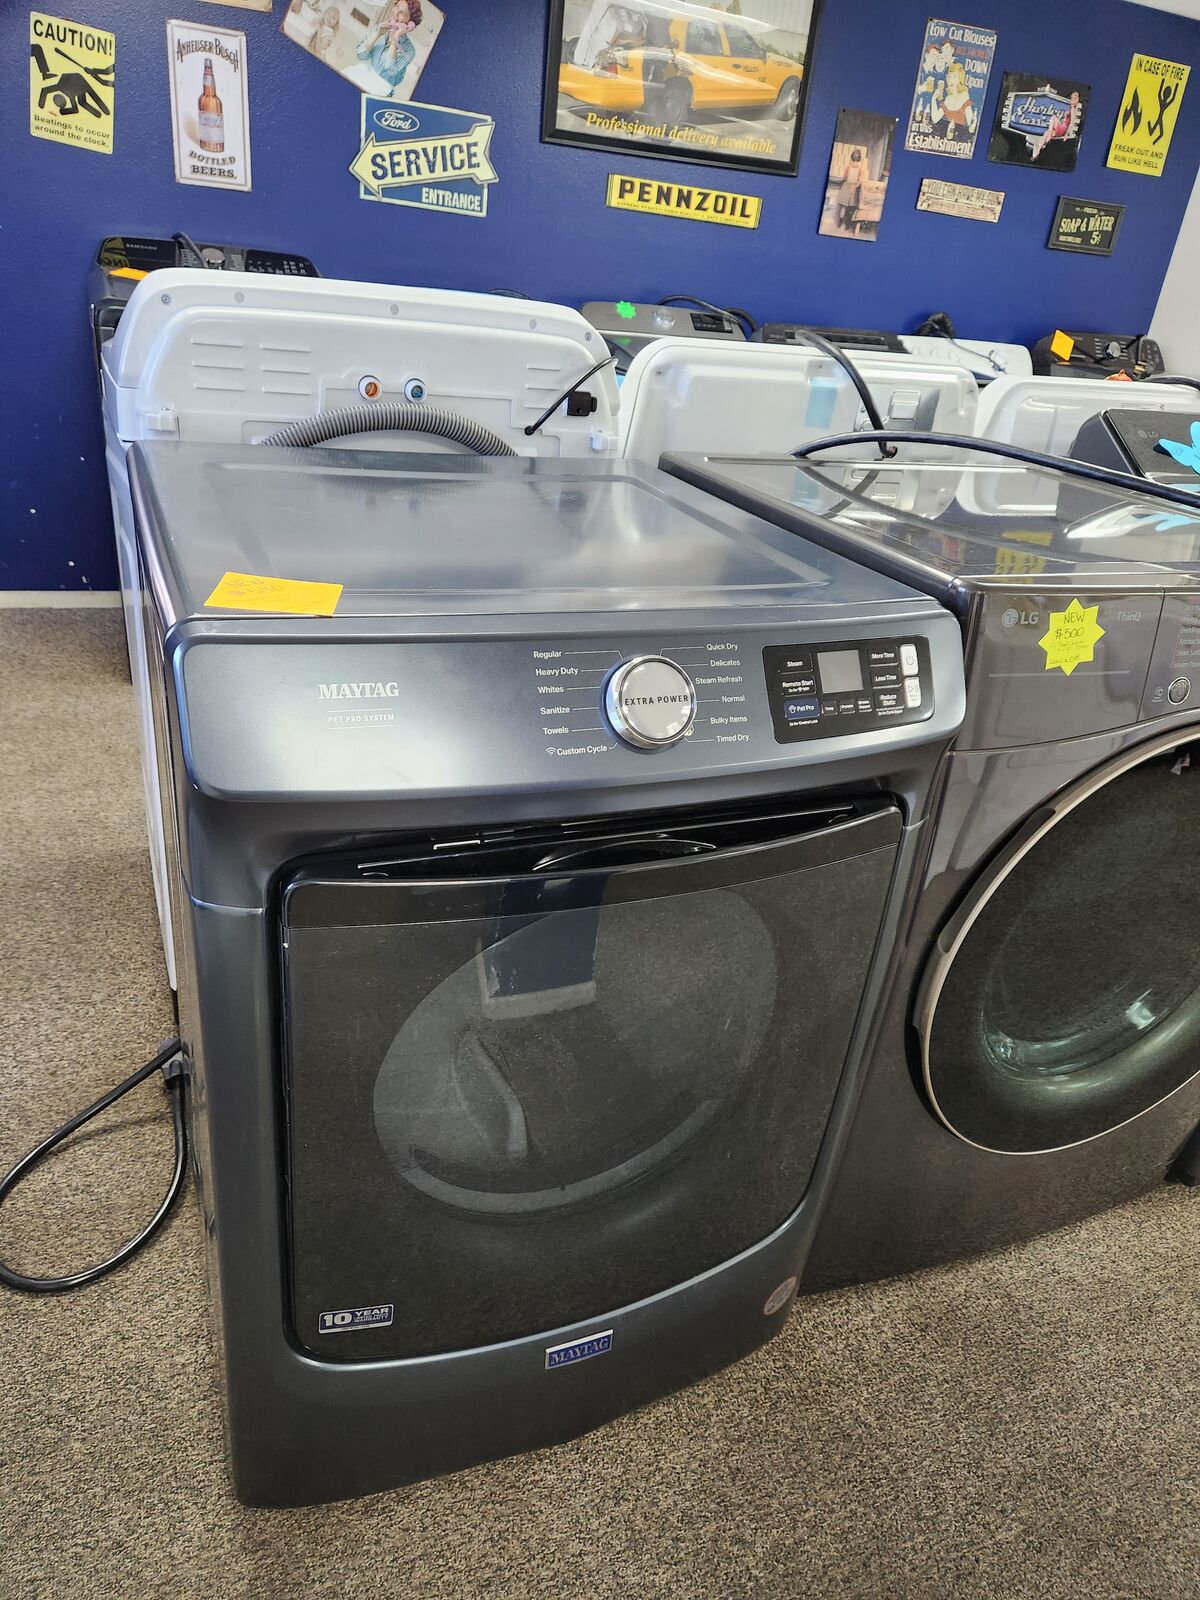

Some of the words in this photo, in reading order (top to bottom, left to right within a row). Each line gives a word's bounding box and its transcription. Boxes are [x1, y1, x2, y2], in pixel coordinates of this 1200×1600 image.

[34, 19, 113, 56] CAUTION!
[930, 23, 947, 37] Low
[949, 27, 963, 41] Cut
[964, 29, 994, 47] Blouses
[965, 59, 989, 74] DOWN
[1136, 58, 1144, 71] IN
[1144, 61, 1161, 76] CASE
[1161, 64, 1171, 76] OF
[1170, 66, 1185, 80] FIRE
[34, 114, 73, 130] Beatings
[74, 123, 85, 133] to
[86, 127, 111, 138] occur
[381, 111, 412, 130] Ford
[34, 124, 65, 137] around
[67, 128, 82, 141] the
[83, 133, 110, 148] clock.
[586, 111, 668, 137] Professional
[669, 126, 719, 147] delivery
[719, 134, 777, 155] available
[908, 132, 972, 155] Establishment
[188, 150, 236, 166] BOTTLED
[1114, 143, 1135, 154] FREAK
[1135, 148, 1149, 156] OUT
[1150, 150, 1164, 160] AND
[371, 141, 481, 180] SERVICE
[1113, 154, 1126, 163] RUN
[1127, 158, 1142, 166] LIKE
[1144, 160, 1159, 168] HELL
[421, 187, 482, 212] ENTRANCE
[618, 178, 752, 218] PENNZOIL
[1058, 217, 1082, 232] SOAP
[1087, 214, 1115, 232] WATER
[1064, 610, 1086, 624] NEW
[1117, 611, 1142, 622] ThinQ
[1055, 627, 1085, 640] $500
[706, 643, 726, 652] Quick
[726, 642, 739, 652] Dry
[533, 650, 563, 660] Regular
[871, 652, 883, 660] More
[710, 659, 741, 667] Delicates
[535, 668, 560, 677] Heavy
[560, 667, 579, 676] Duty
[695, 677, 717, 685] Steam
[717, 675, 743, 684] Refresh
[318, 682, 400, 699] MAYTAG
[537, 686, 565, 694] Whites
[624, 696, 655, 706] EXTRA
[657, 694, 690, 704] POWER
[721, 694, 746, 703] Normal
[540, 706, 571, 715] Sanitize
[327, 716, 342, 724] PET
[345, 715, 361, 724] PRO
[364, 714, 394, 722] SYSTEM
[710, 716, 729, 726] Bulky
[729, 715, 748, 723] Items
[542, 726, 570, 735] Towels
[716, 734, 737, 743] Timed
[737, 734, 750, 742] Dry
[556, 747, 586, 756] Custom
[586, 744, 608, 754] Cycle
[323, 1312, 353, 1326] 10
[355, 1307, 389, 1317] YEAR
[550, 1338, 609, 1364] MAYTAG
